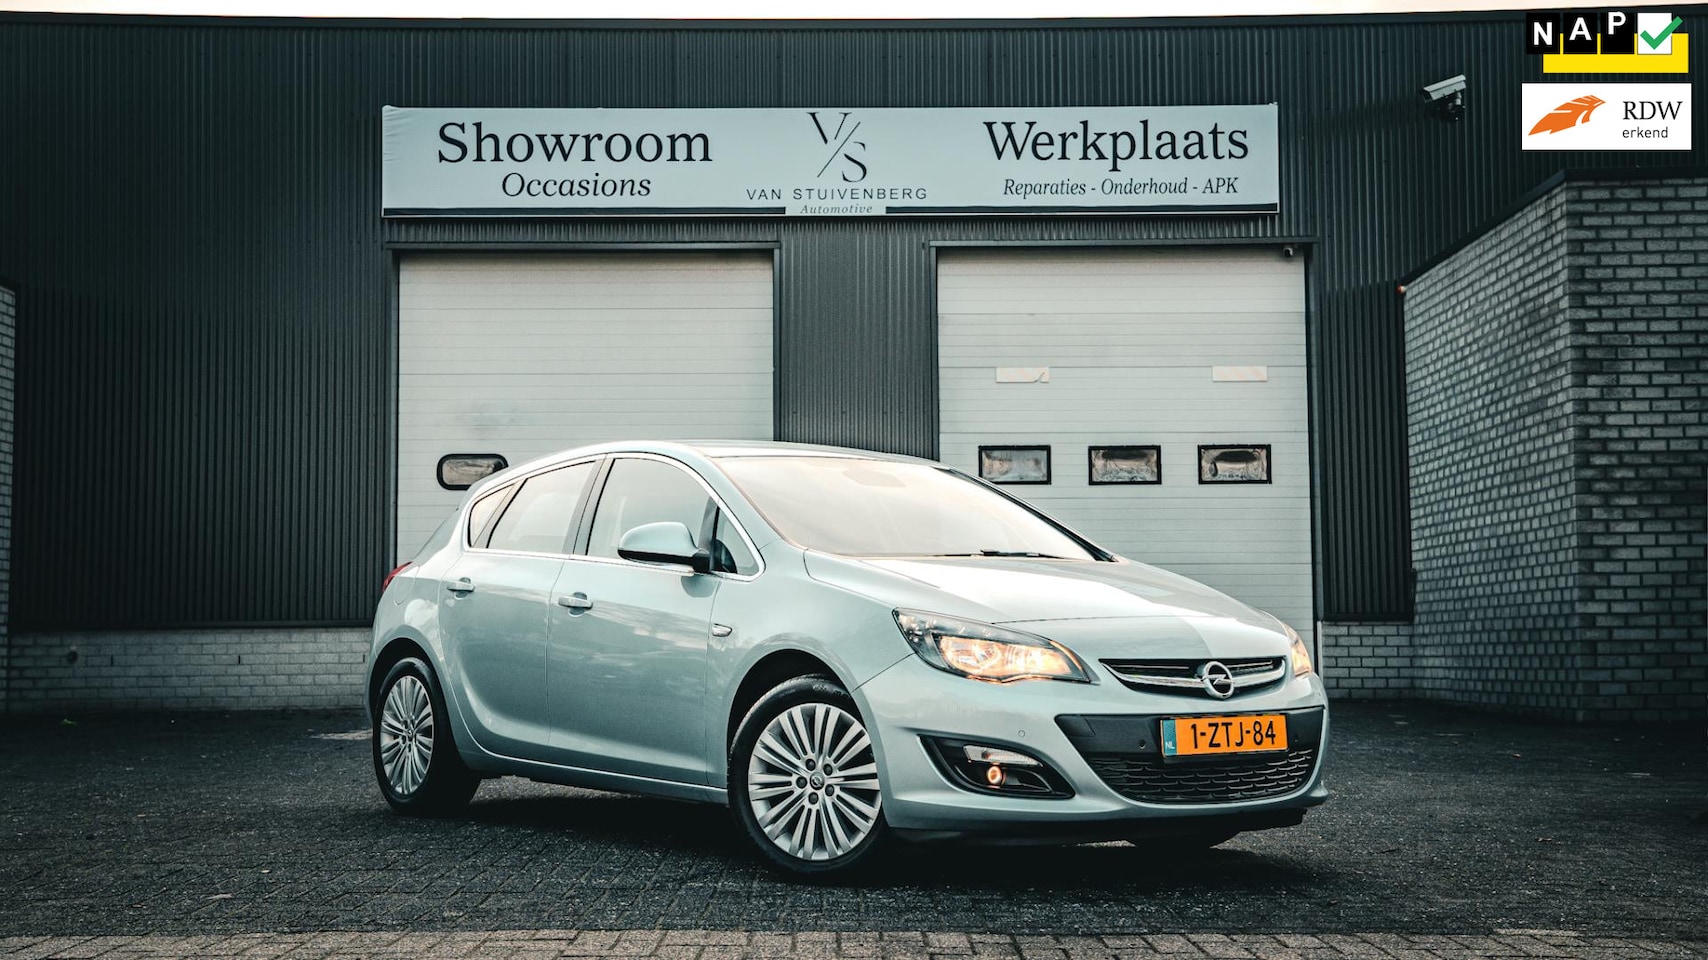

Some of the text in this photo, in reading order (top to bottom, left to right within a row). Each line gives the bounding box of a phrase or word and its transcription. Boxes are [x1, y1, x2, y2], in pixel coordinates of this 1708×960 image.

[438, 121, 713, 163] Showroom
[983, 119, 1249, 172] Werkplaats
[502, 172, 651, 197] Occasions
[746, 187, 928, 200] VAN STUIVENBERG
[1003, 178, 1087, 199] Reparaties
[1101, 177, 1188, 195] Onderhoud
[1202, 177, 1239, 194] APK
[800, 203, 873, 215] Automotive
[1165, 741, 1175, 750] NL
[1191, 720, 1276, 749] 1-ZTJ-84
